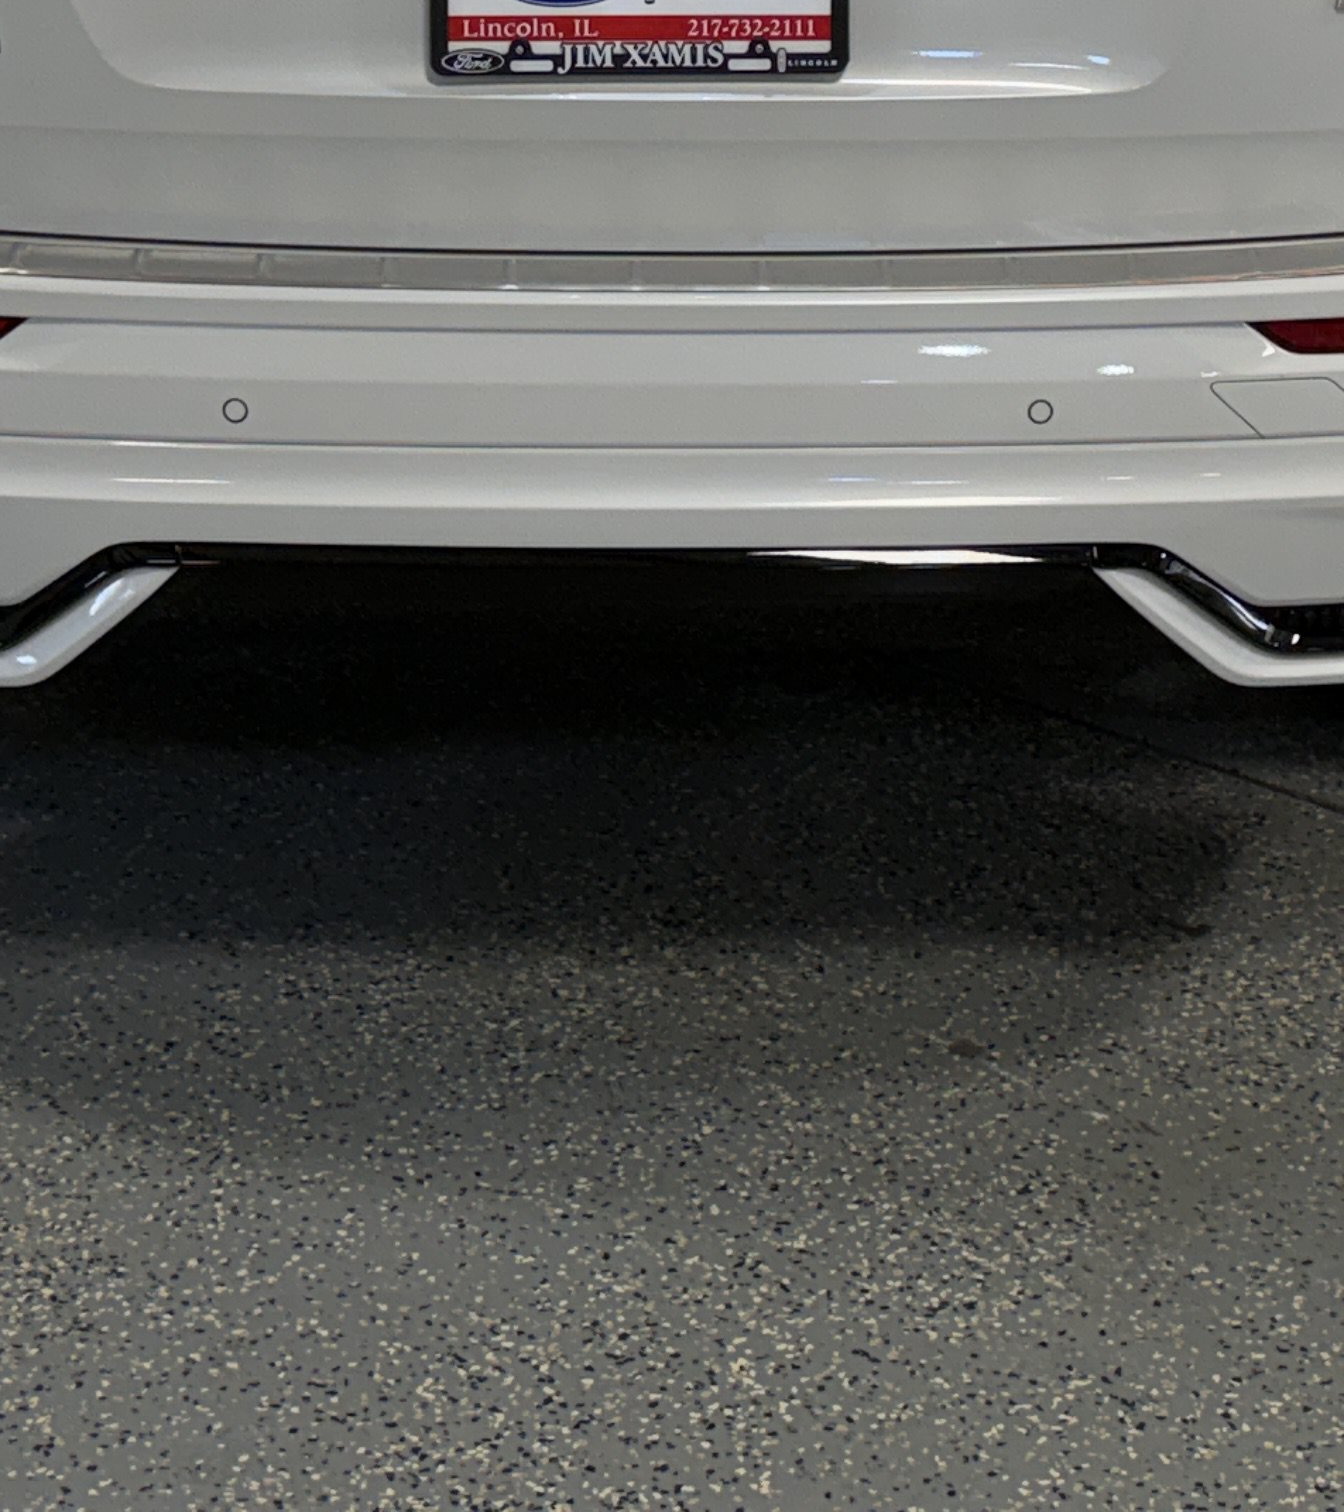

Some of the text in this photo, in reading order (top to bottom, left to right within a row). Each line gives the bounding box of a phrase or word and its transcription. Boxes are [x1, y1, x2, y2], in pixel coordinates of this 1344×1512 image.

[462, 19, 599, 39] Lincoln, IL
[687, 19, 816, 37] 217-732-2111
[557, 42, 725, 74] JIM XAMIS
